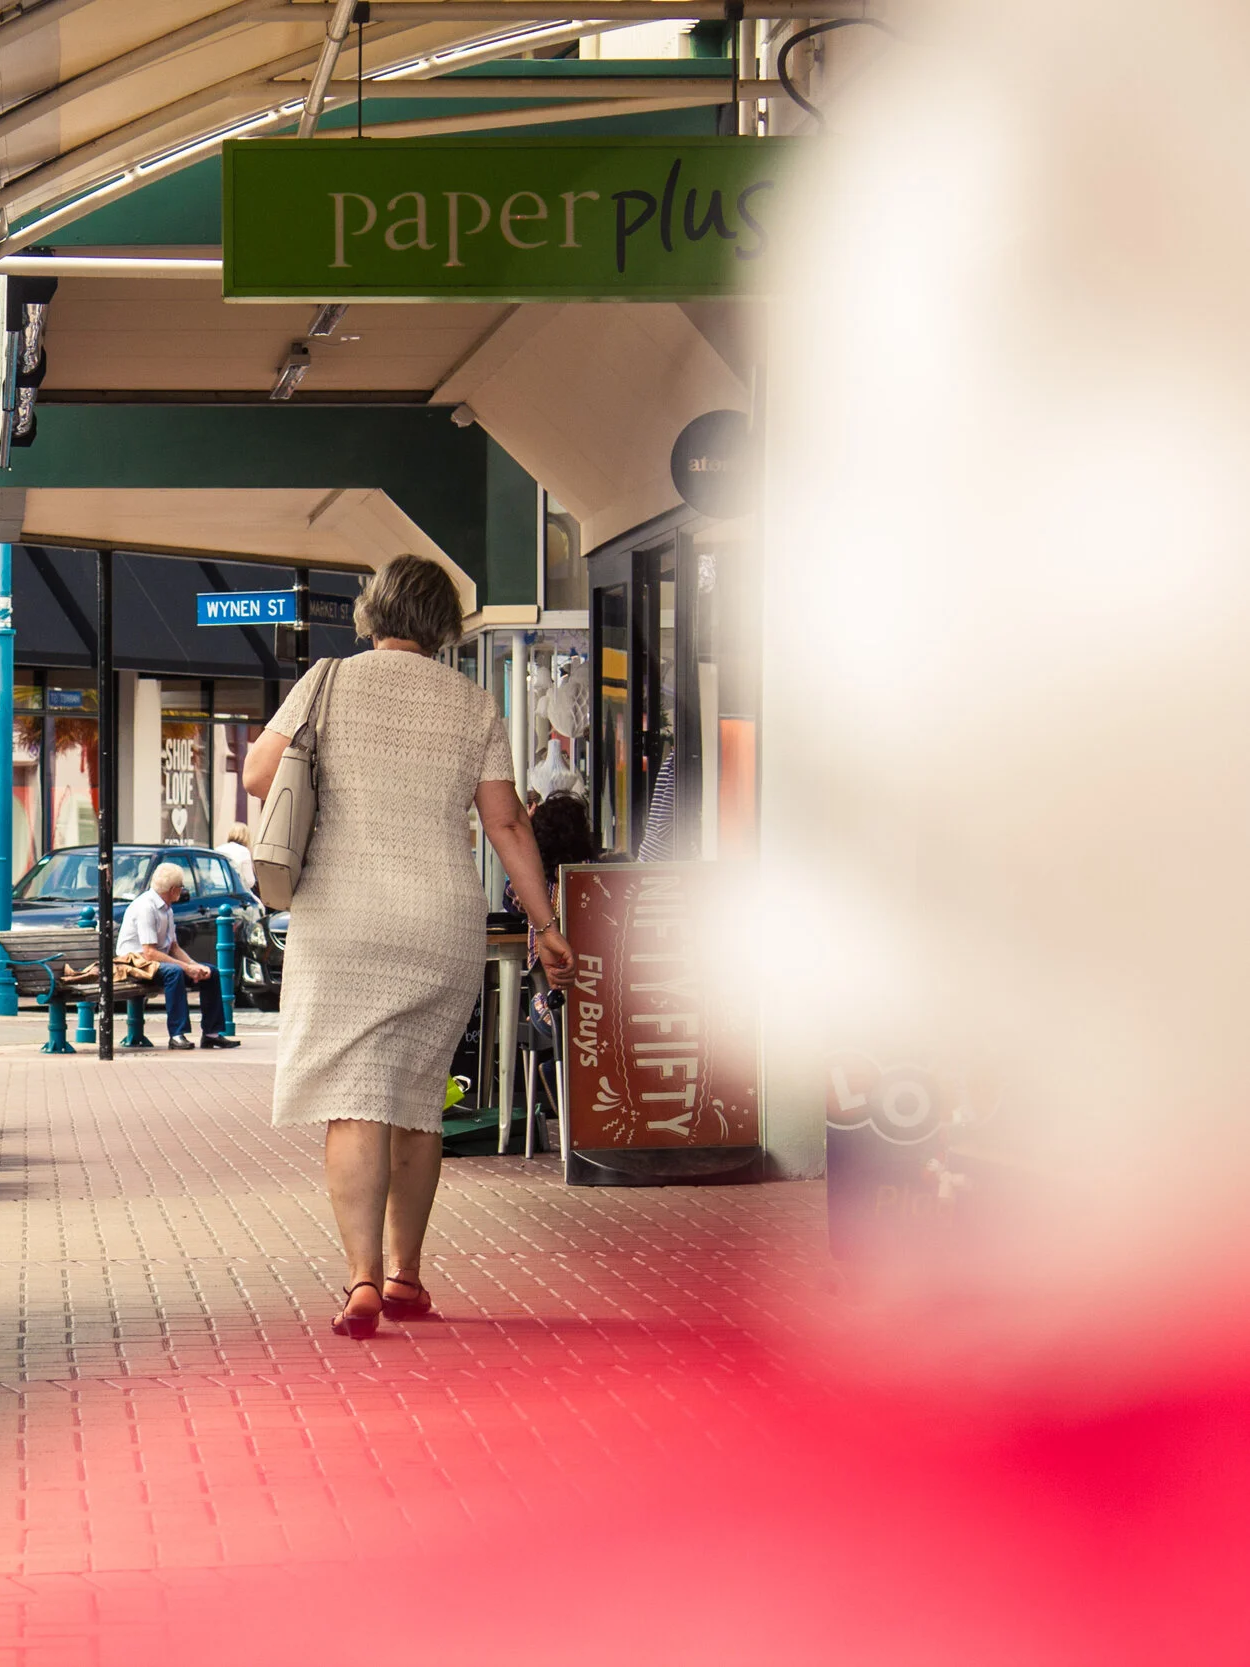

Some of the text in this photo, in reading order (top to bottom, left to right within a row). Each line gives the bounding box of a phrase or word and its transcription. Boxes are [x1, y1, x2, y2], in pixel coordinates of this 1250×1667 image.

[327, 158, 775, 274] paper plus
[206, 598, 286, 618] WYNEN ST
[310, 600, 350, 620] MARKET ST
[165, 738, 194, 771] SHOE
[165, 772, 194, 805] LOVE
[572, 953, 604, 1068] Fly Buys
[629, 1012, 699, 1138] FIFTY
